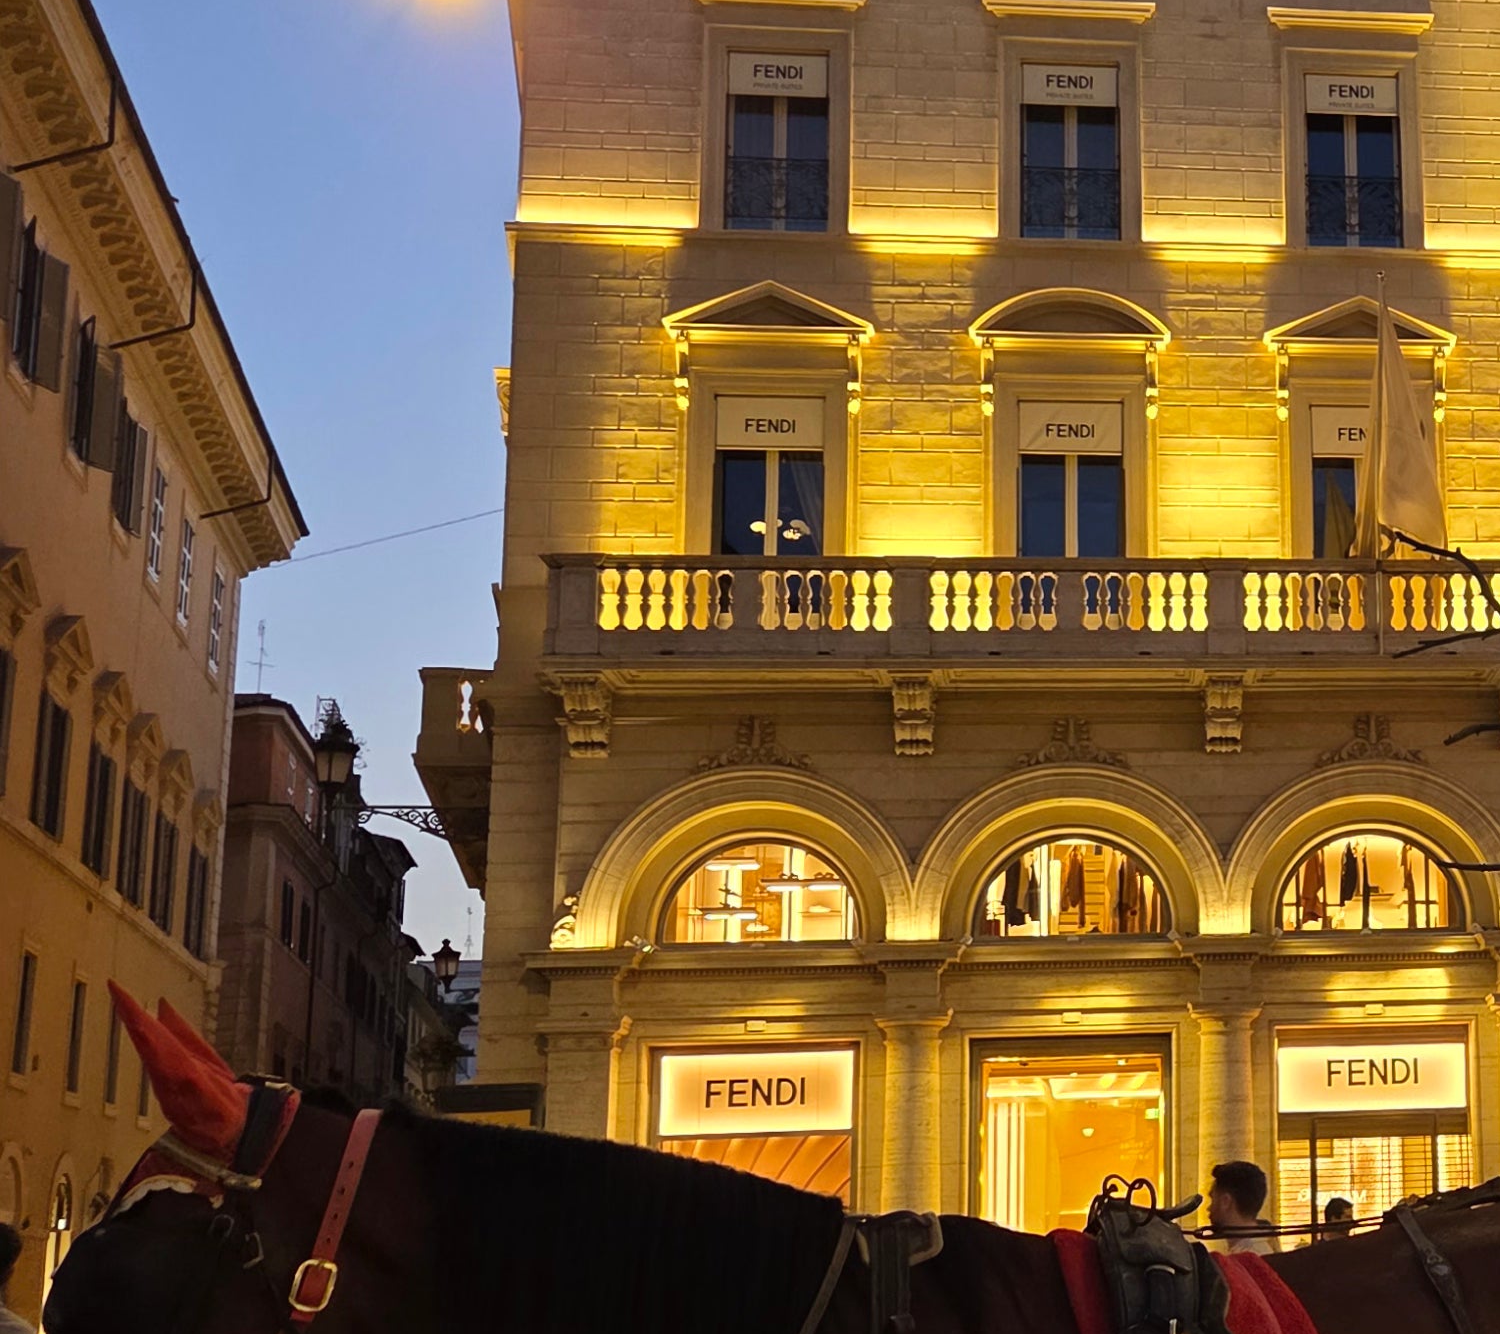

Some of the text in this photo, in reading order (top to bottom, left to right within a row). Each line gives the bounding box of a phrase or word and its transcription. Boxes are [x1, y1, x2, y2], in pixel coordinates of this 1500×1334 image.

[753, 64, 803, 79] FENDI
[1046, 74, 1093, 89] FENDI
[1329, 84, 1374, 99] FENDI
[745, 418, 796, 433] FENDI
[1046, 423, 1095, 438] FENDI
[1338, 428, 1367, 441] FEN
[1327, 1057, 1418, 1087] FENDI
[705, 1077, 806, 1108] FENDI
